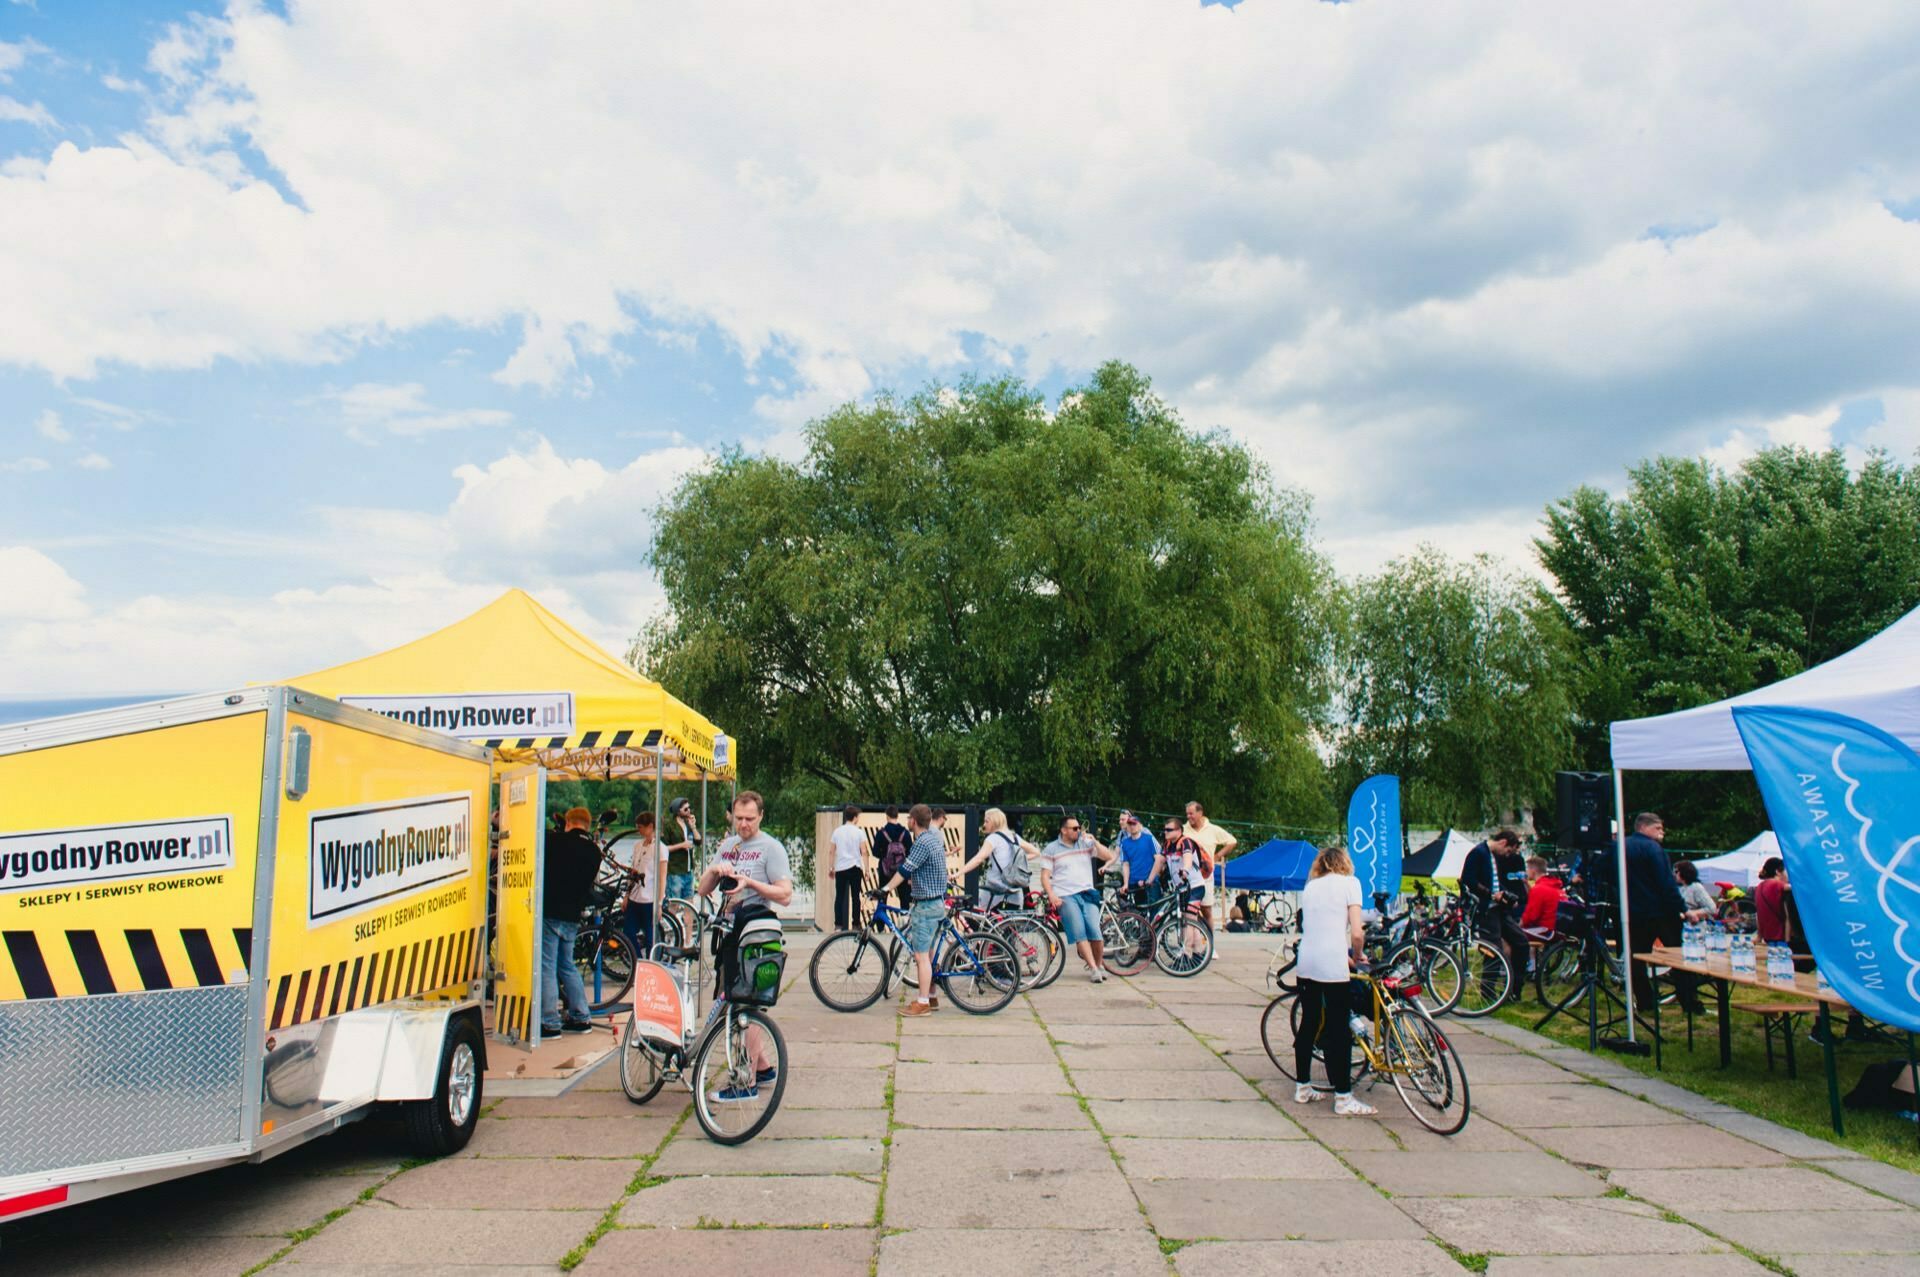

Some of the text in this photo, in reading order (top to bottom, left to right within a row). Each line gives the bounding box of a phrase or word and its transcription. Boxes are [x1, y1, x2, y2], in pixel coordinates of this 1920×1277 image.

[366, 702, 564, 730] odnyRower.pl
[320, 814, 466, 893] WygodnyRower.pl
[502, 848, 526, 866] SERWIS
[19, 875, 224, 908] SKLEPY I SERWISY ROWEROWE
[501, 871, 533, 889] MOBILNY
[354, 887, 467, 942] SKLEPY I SERWISY ROWEROWE
